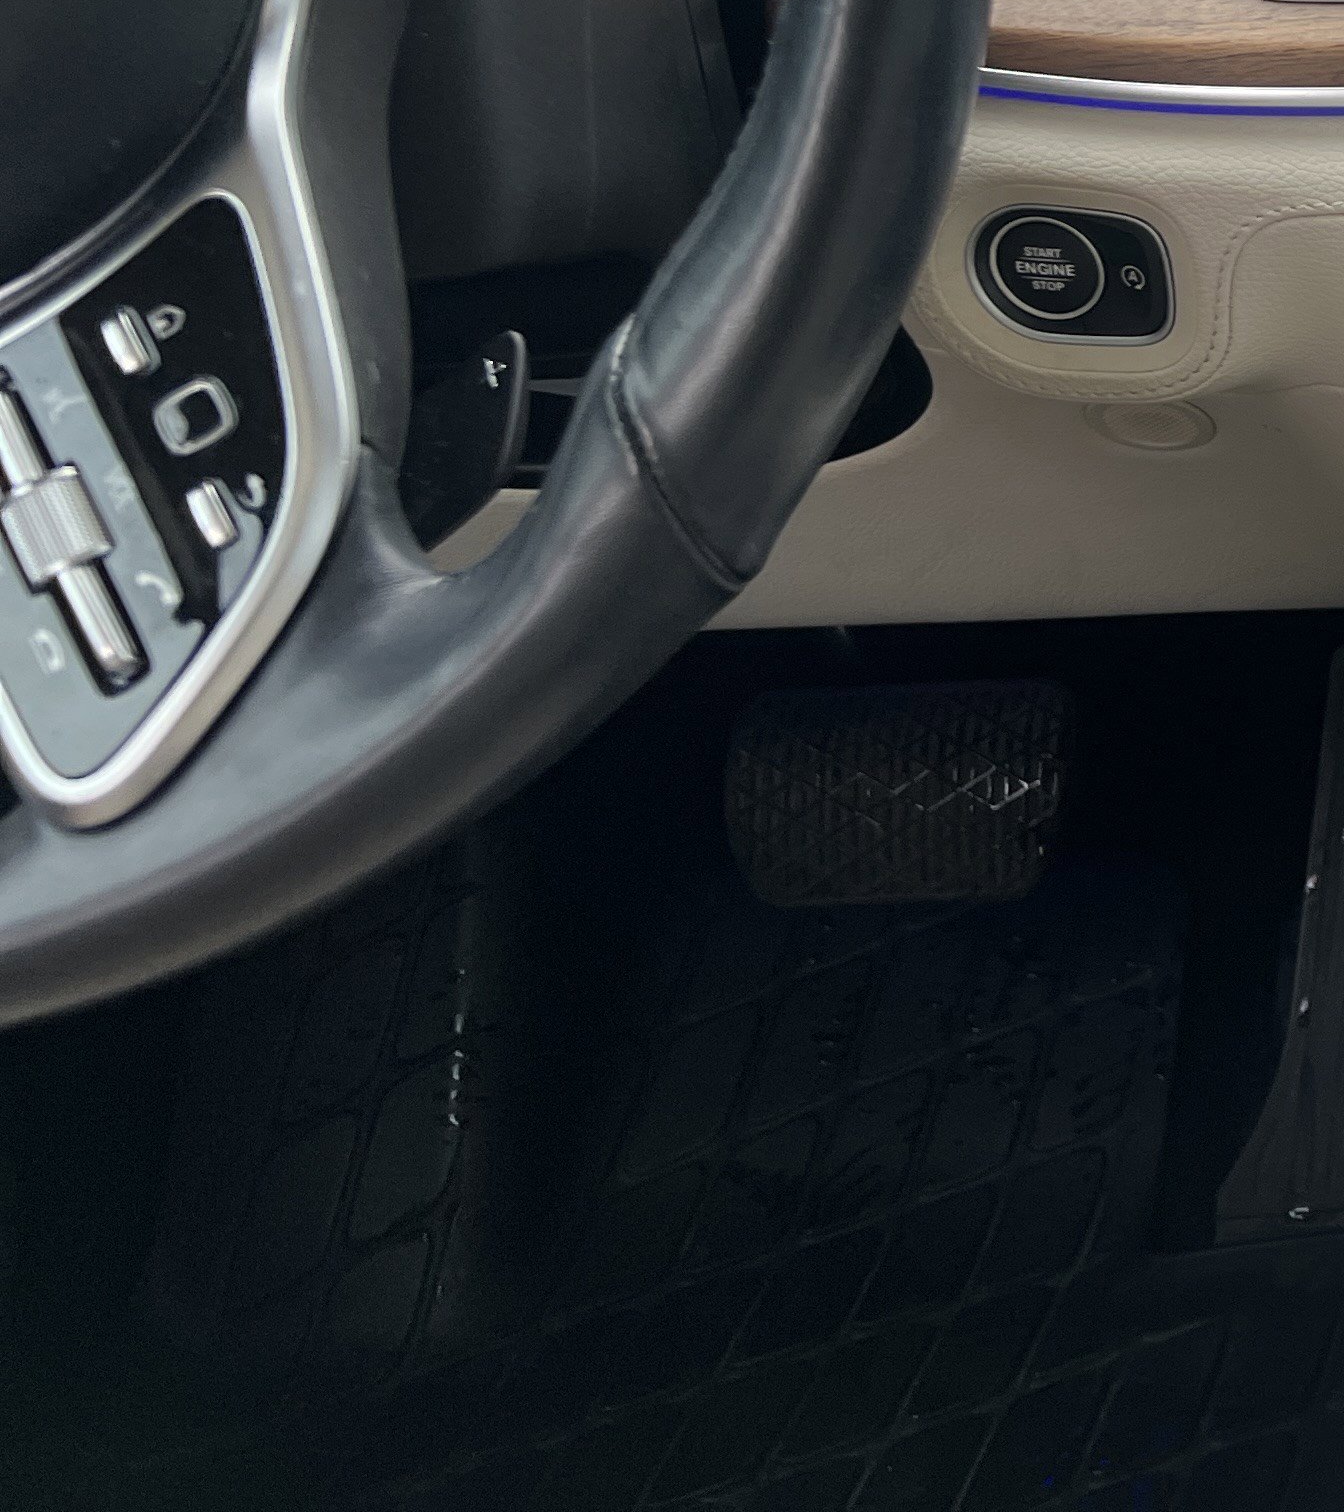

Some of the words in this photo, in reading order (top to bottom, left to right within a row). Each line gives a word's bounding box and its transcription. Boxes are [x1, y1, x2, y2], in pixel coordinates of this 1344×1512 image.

[1023, 246, 1062, 258] START
[1014, 260, 1076, 277] ENGINE
[1031, 280, 1066, 292] STOP
